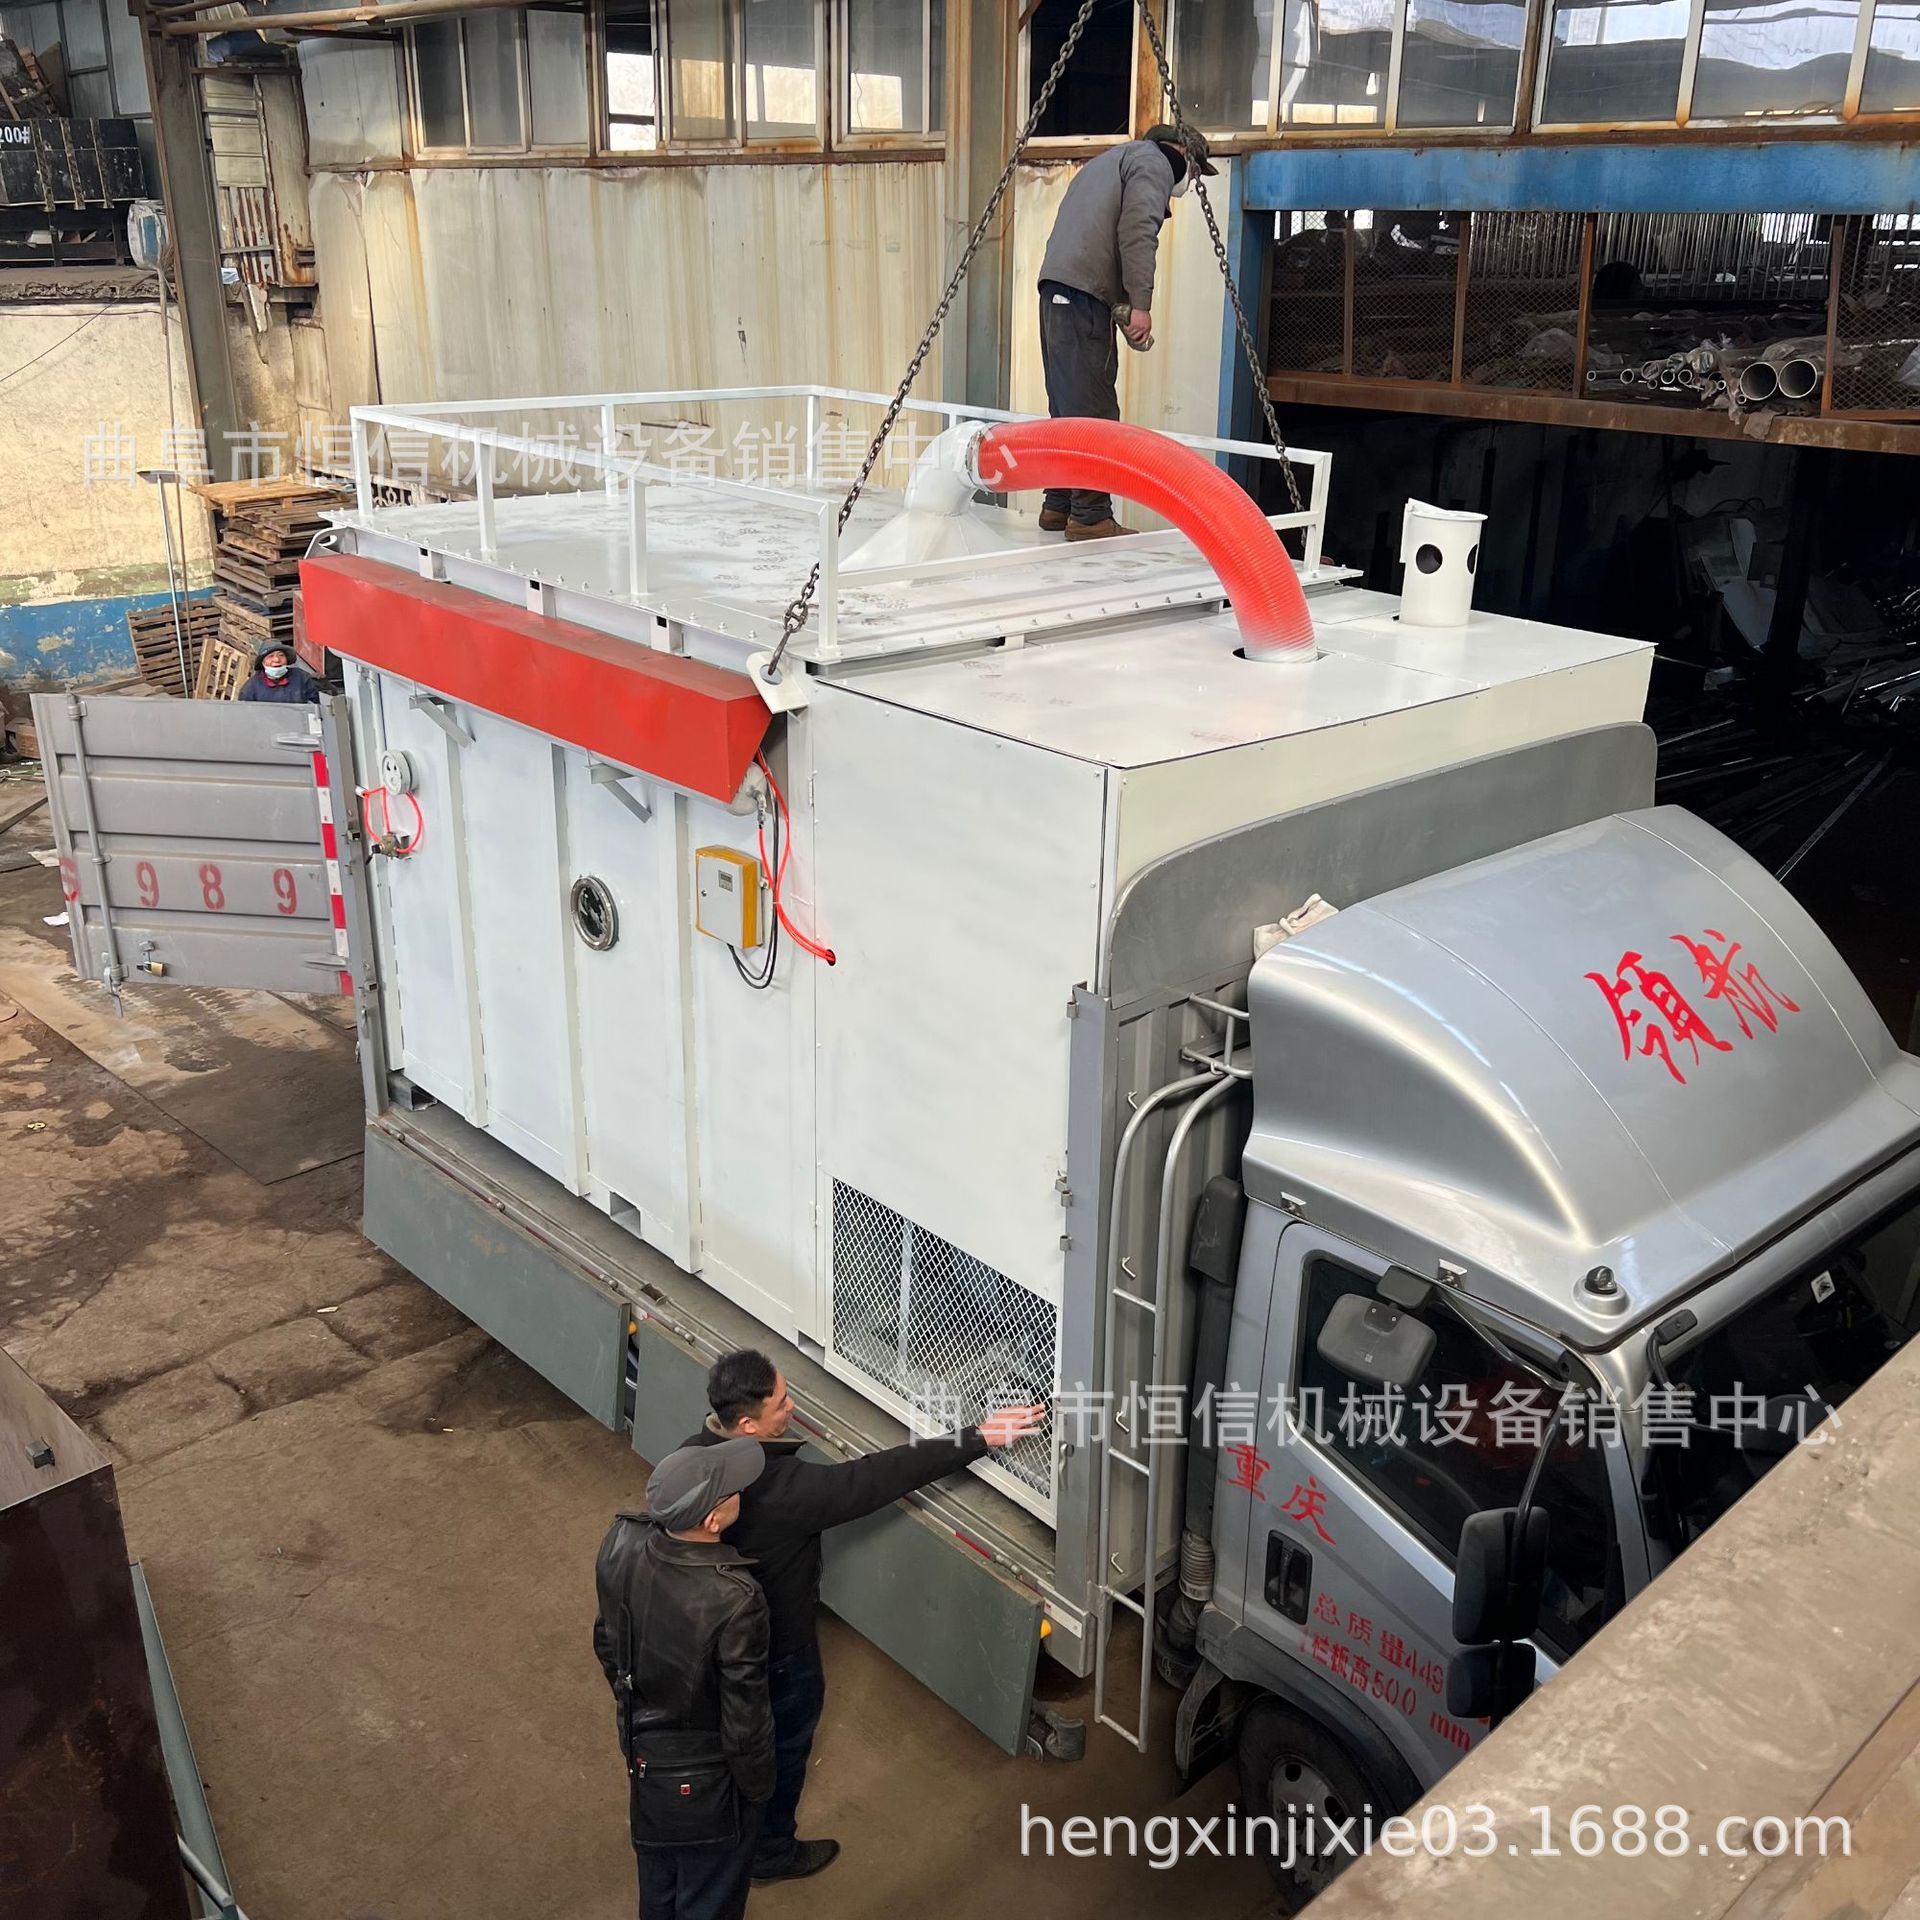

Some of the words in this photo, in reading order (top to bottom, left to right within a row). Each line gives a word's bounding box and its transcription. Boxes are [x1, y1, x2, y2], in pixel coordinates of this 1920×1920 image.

[1226, 1443, 1337, 1546] 重庆
[1313, 1592, 1445, 1695] 总质量449
